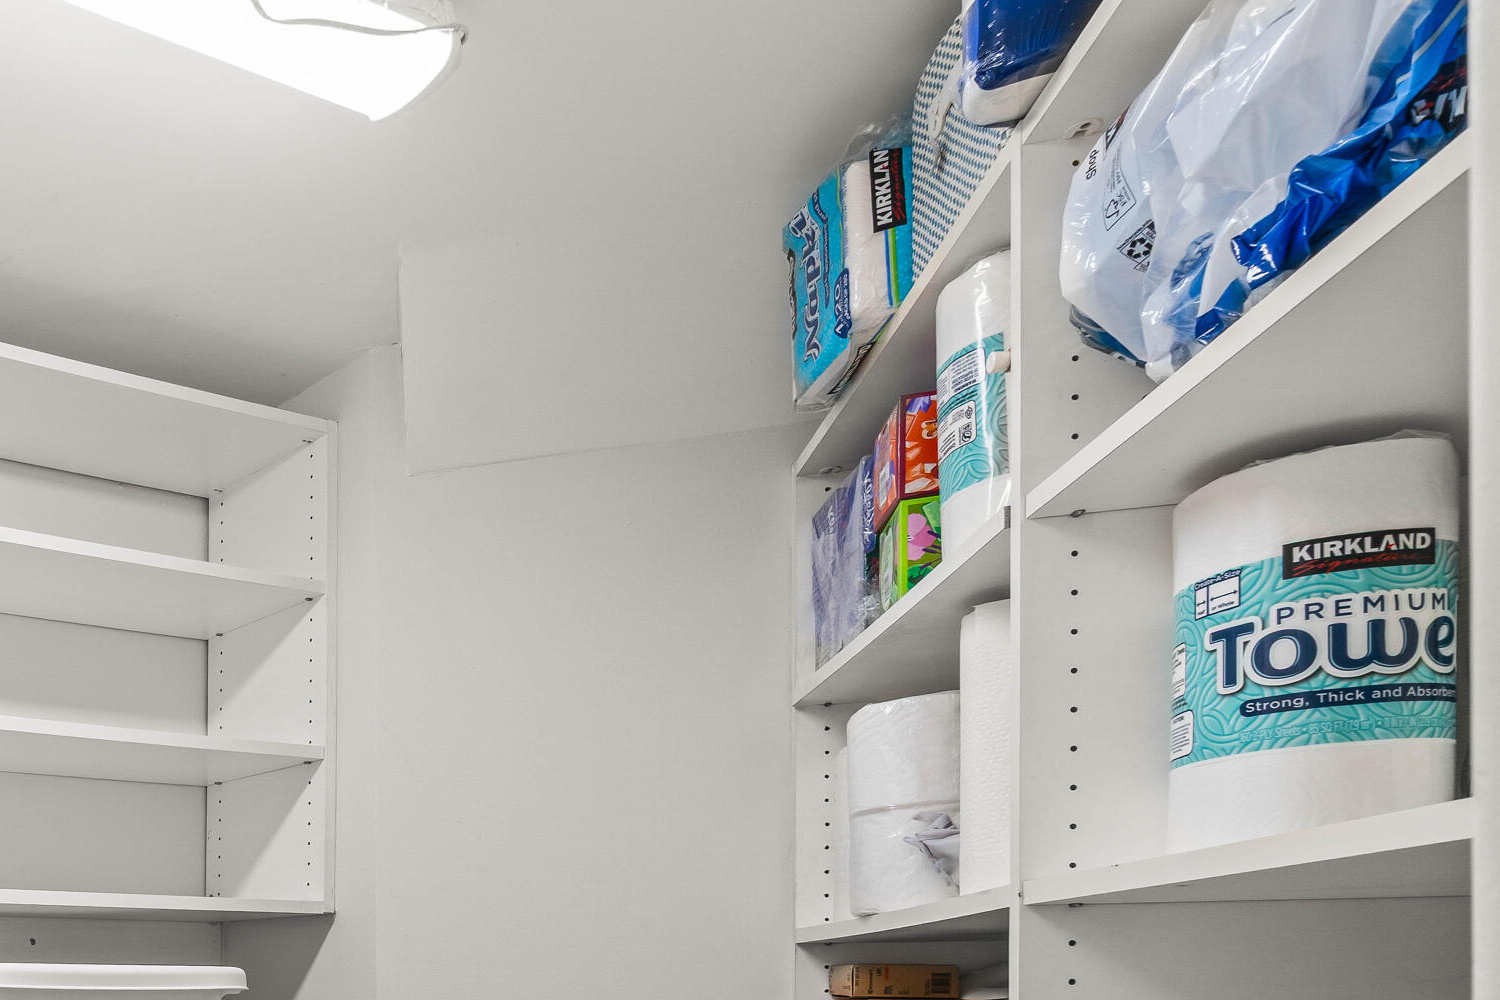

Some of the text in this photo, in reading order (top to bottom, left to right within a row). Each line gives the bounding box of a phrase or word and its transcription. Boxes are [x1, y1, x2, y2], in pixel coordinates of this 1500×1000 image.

[1291, 532, 1432, 564] KIRKLAND
[1194, 568, 1242, 591] Create-A-Size
[1277, 592, 1450, 625] PREMIUM
[1245, 695, 1310, 714] Strong,
[1317, 689, 1365, 704] Thick
[1372, 686, 1403, 698] and
